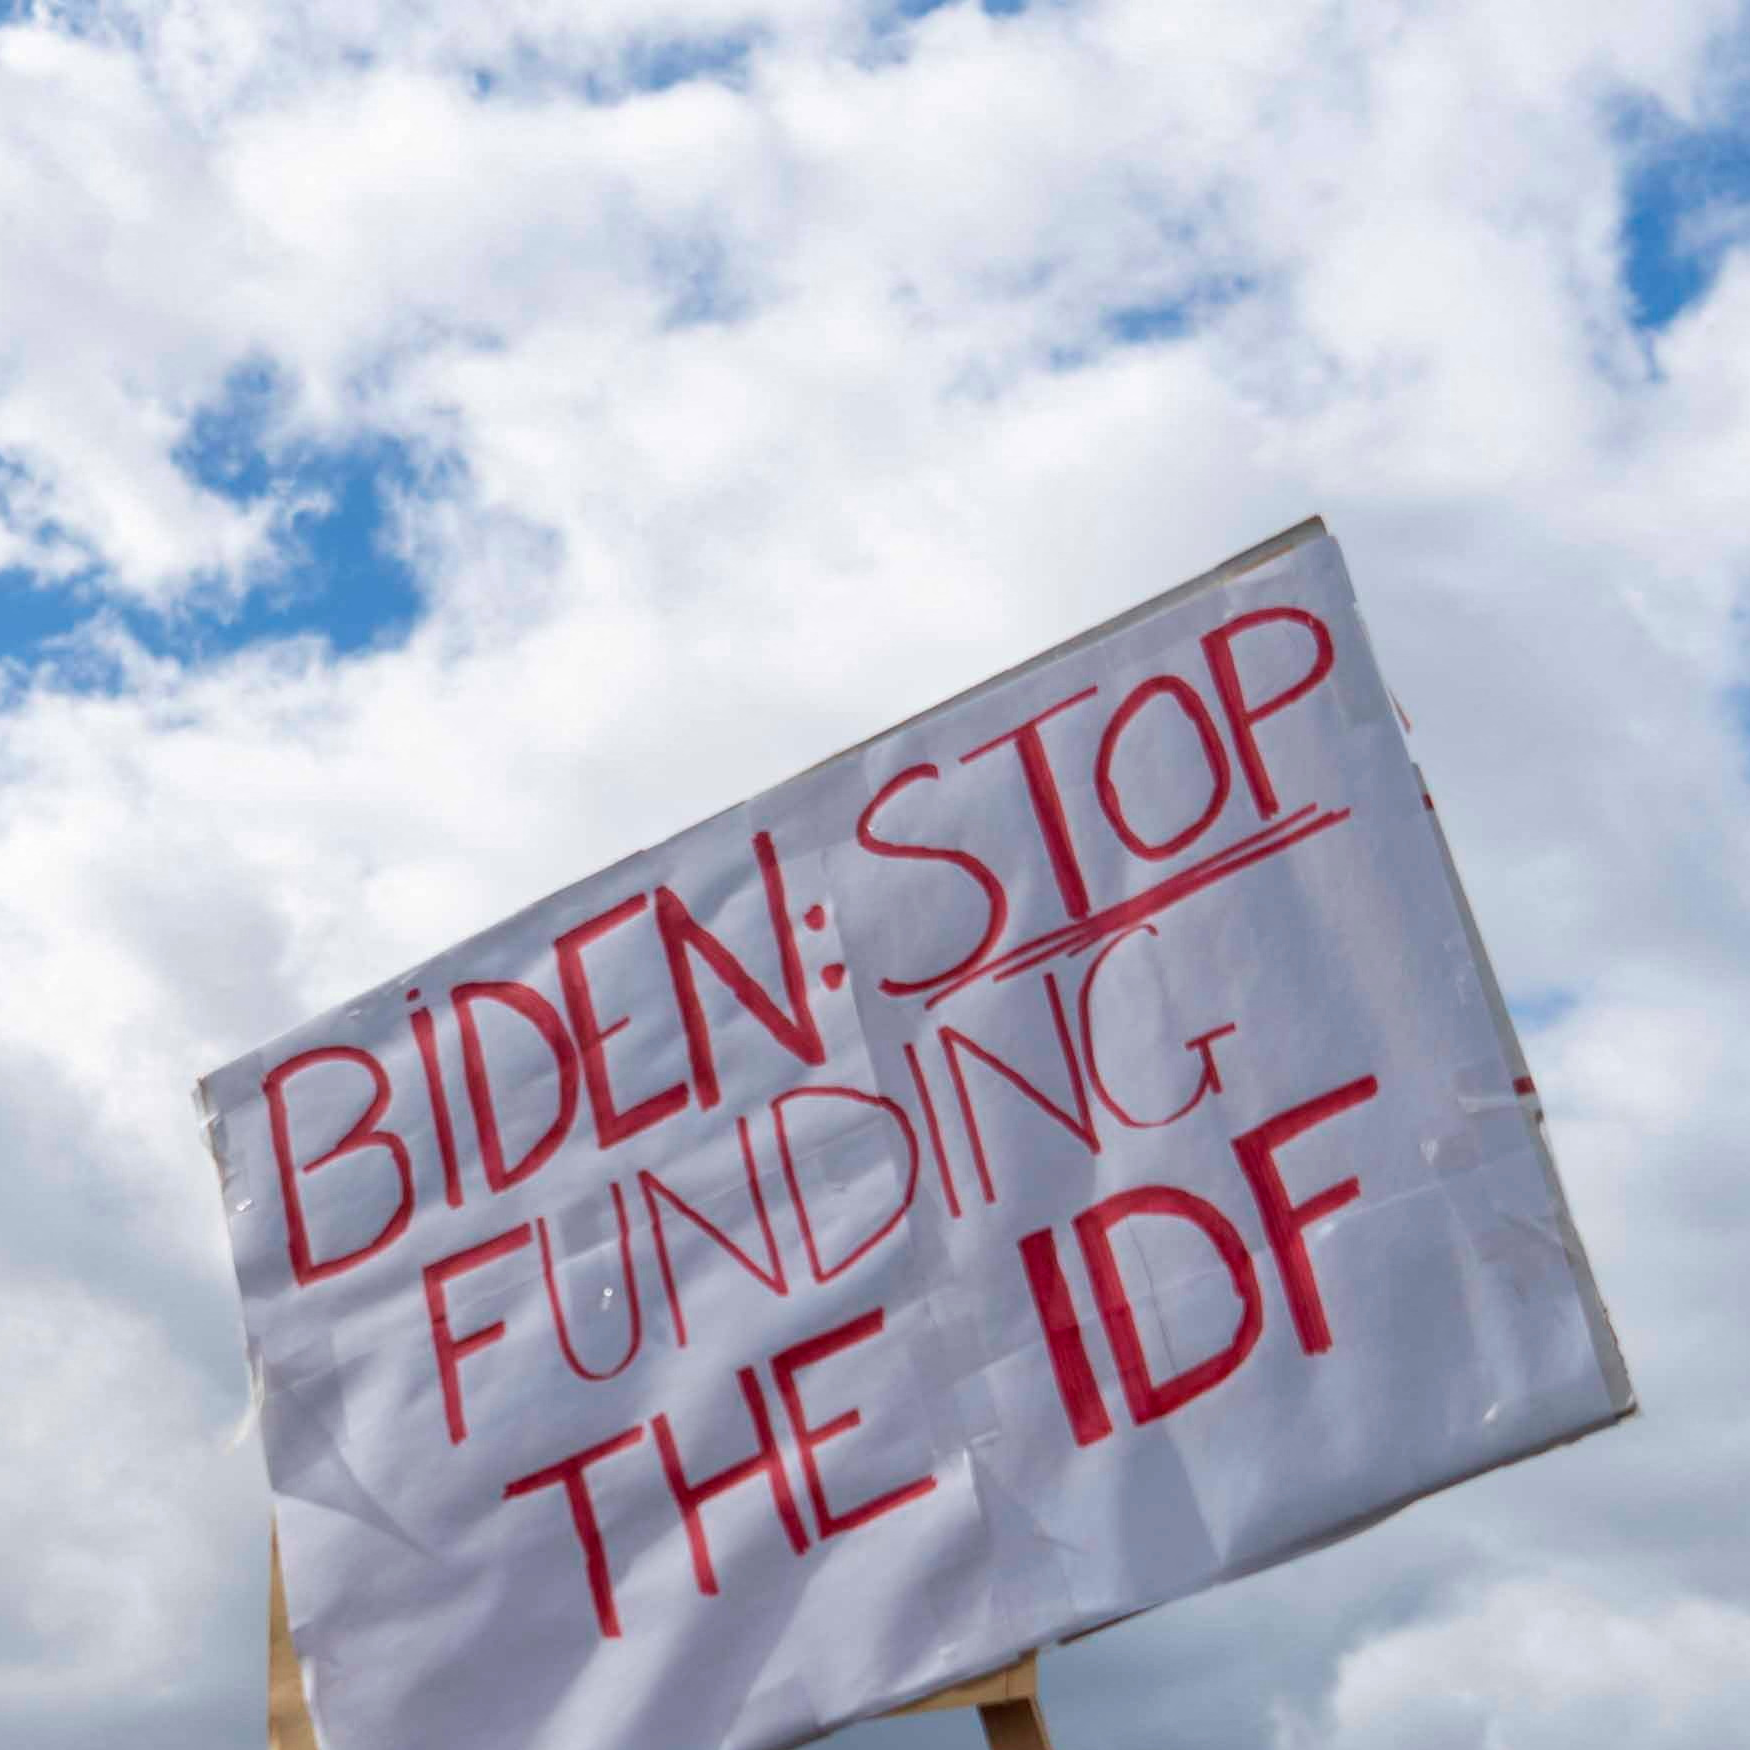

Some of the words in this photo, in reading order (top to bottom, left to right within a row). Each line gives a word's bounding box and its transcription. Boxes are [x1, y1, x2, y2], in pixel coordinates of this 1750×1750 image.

[856, 607, 1336, 998] STOP
[424, 925, 1237, 1445] FUNDING
[503, 1307, 938, 1639] THE
[1019, 1075, 1378, 1448] IDF
